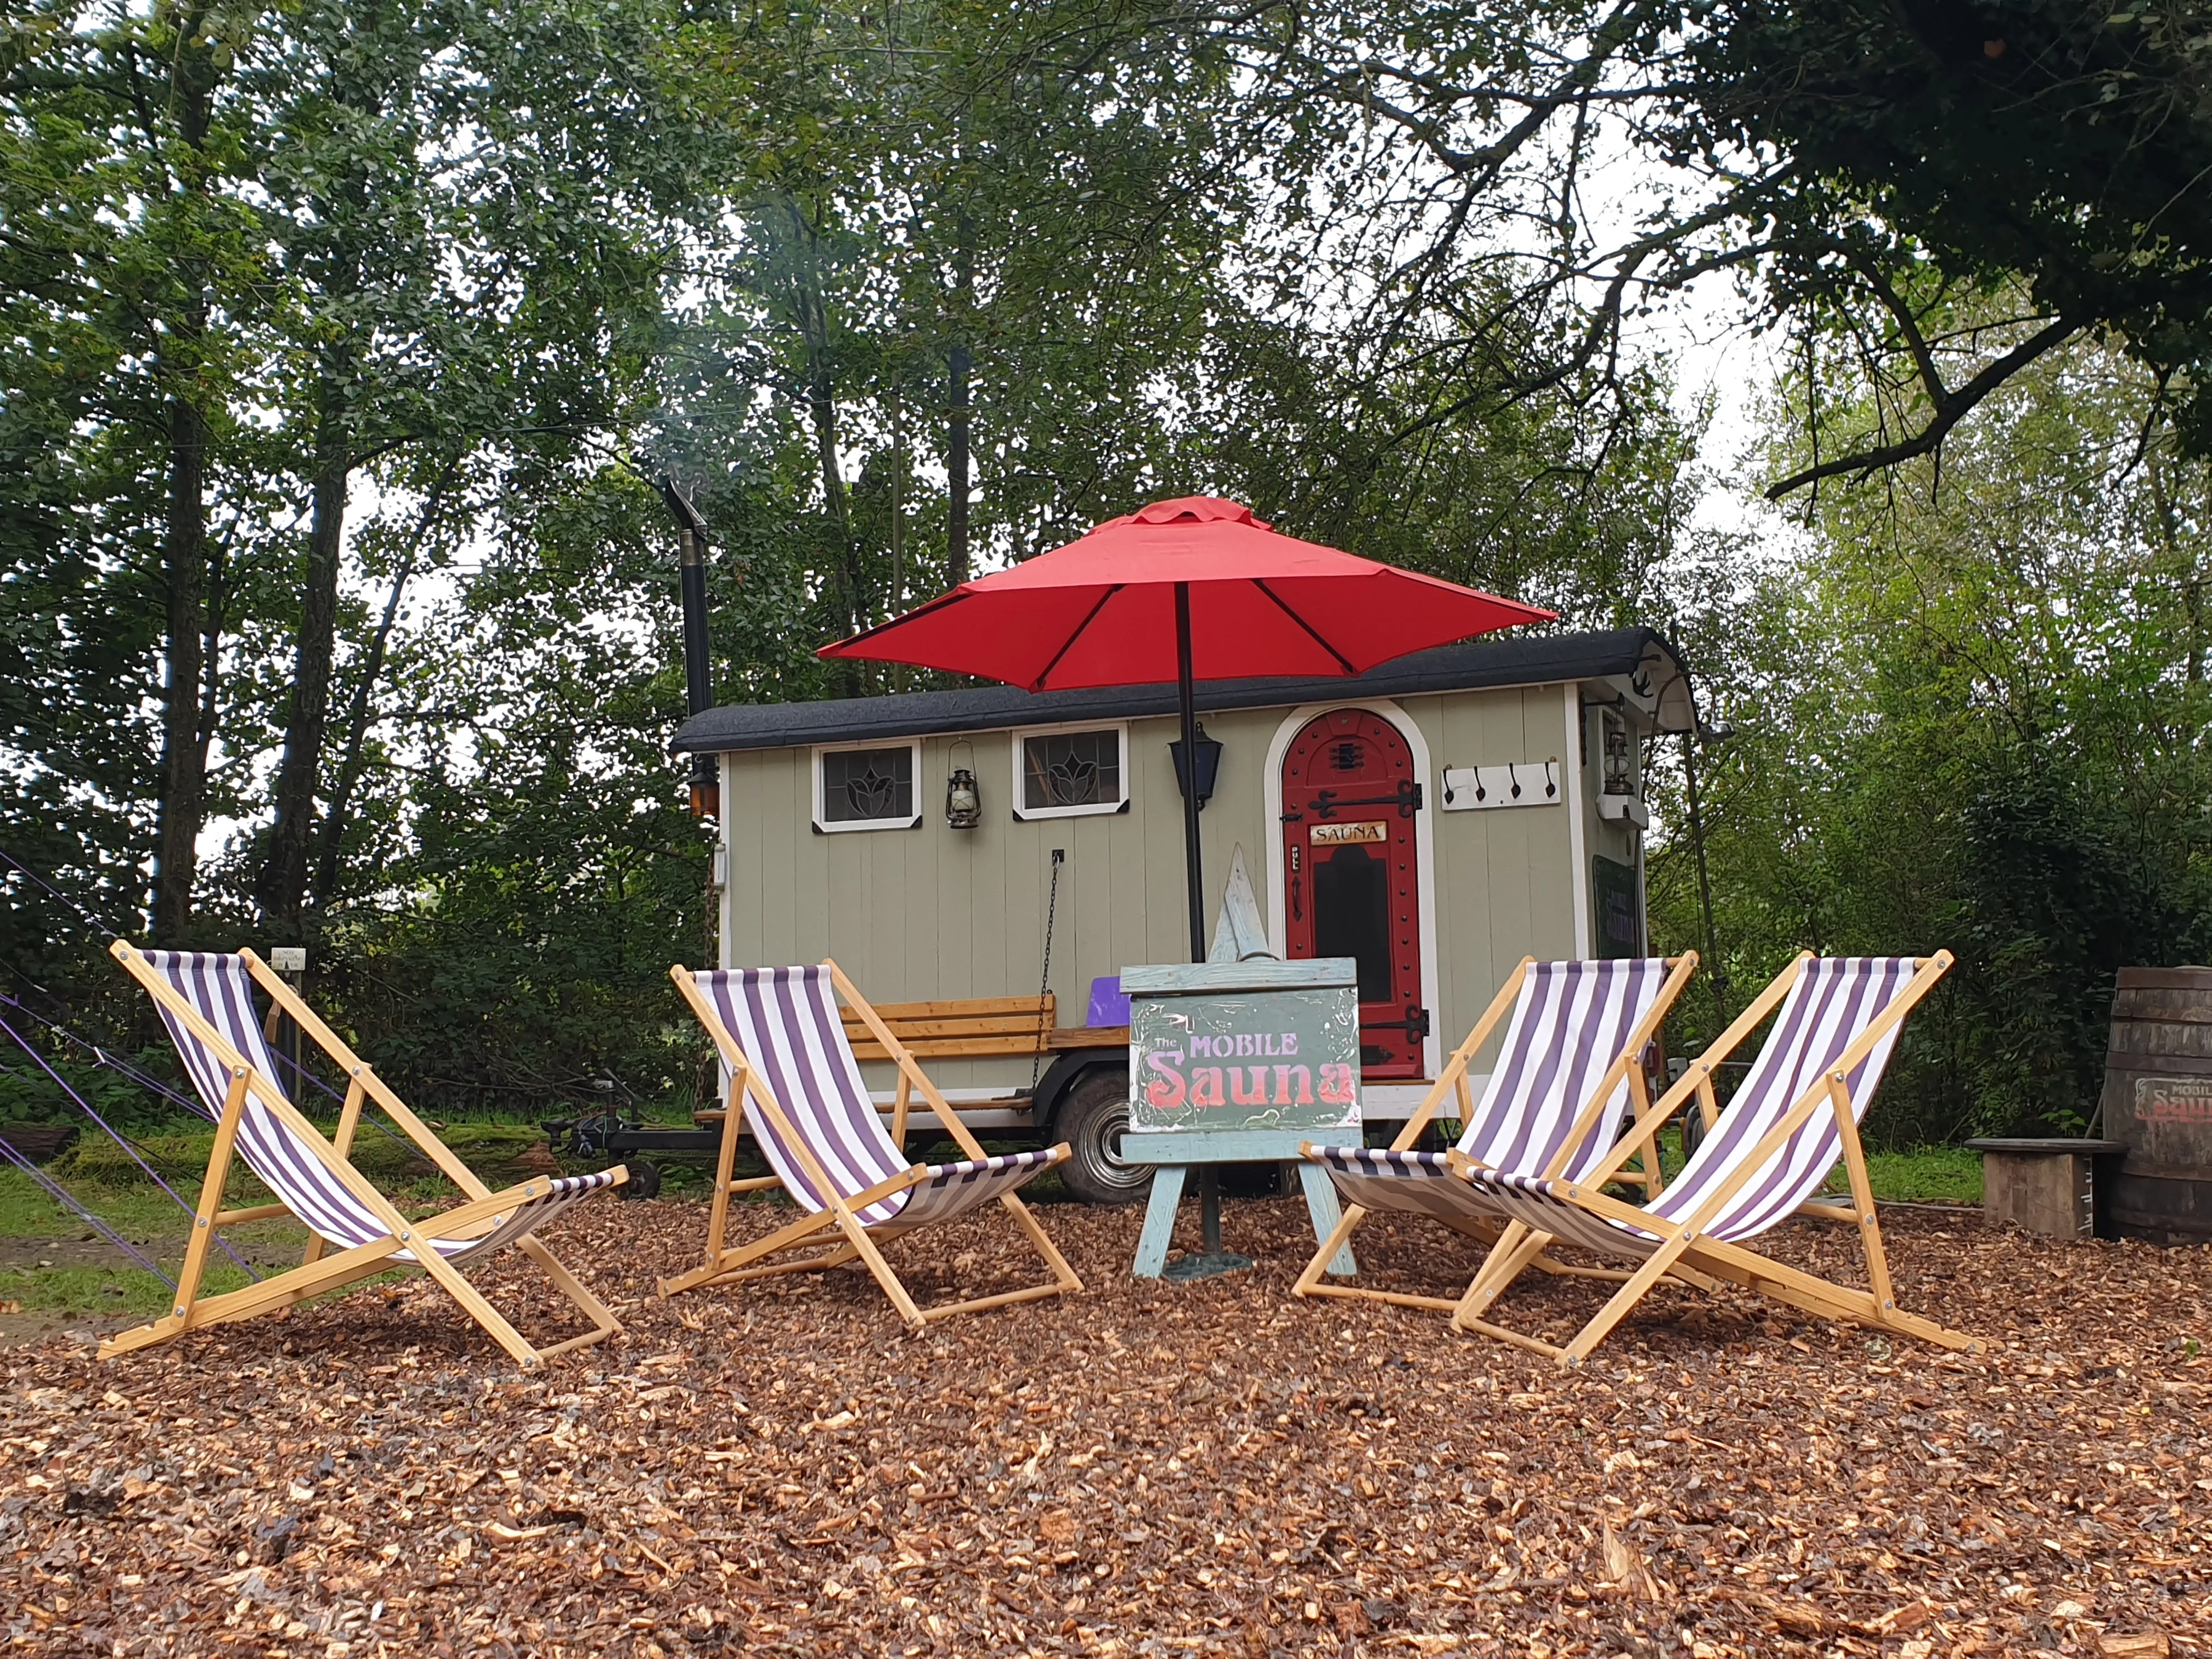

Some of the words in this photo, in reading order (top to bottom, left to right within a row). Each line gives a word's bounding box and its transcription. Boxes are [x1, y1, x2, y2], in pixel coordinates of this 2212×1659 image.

[1316, 826, 1380, 842] SAUNA
[1154, 1038, 1177, 1047] The
[1190, 1032, 1299, 1058] MOBILE
[1146, 1050, 1354, 1108] Sauna
